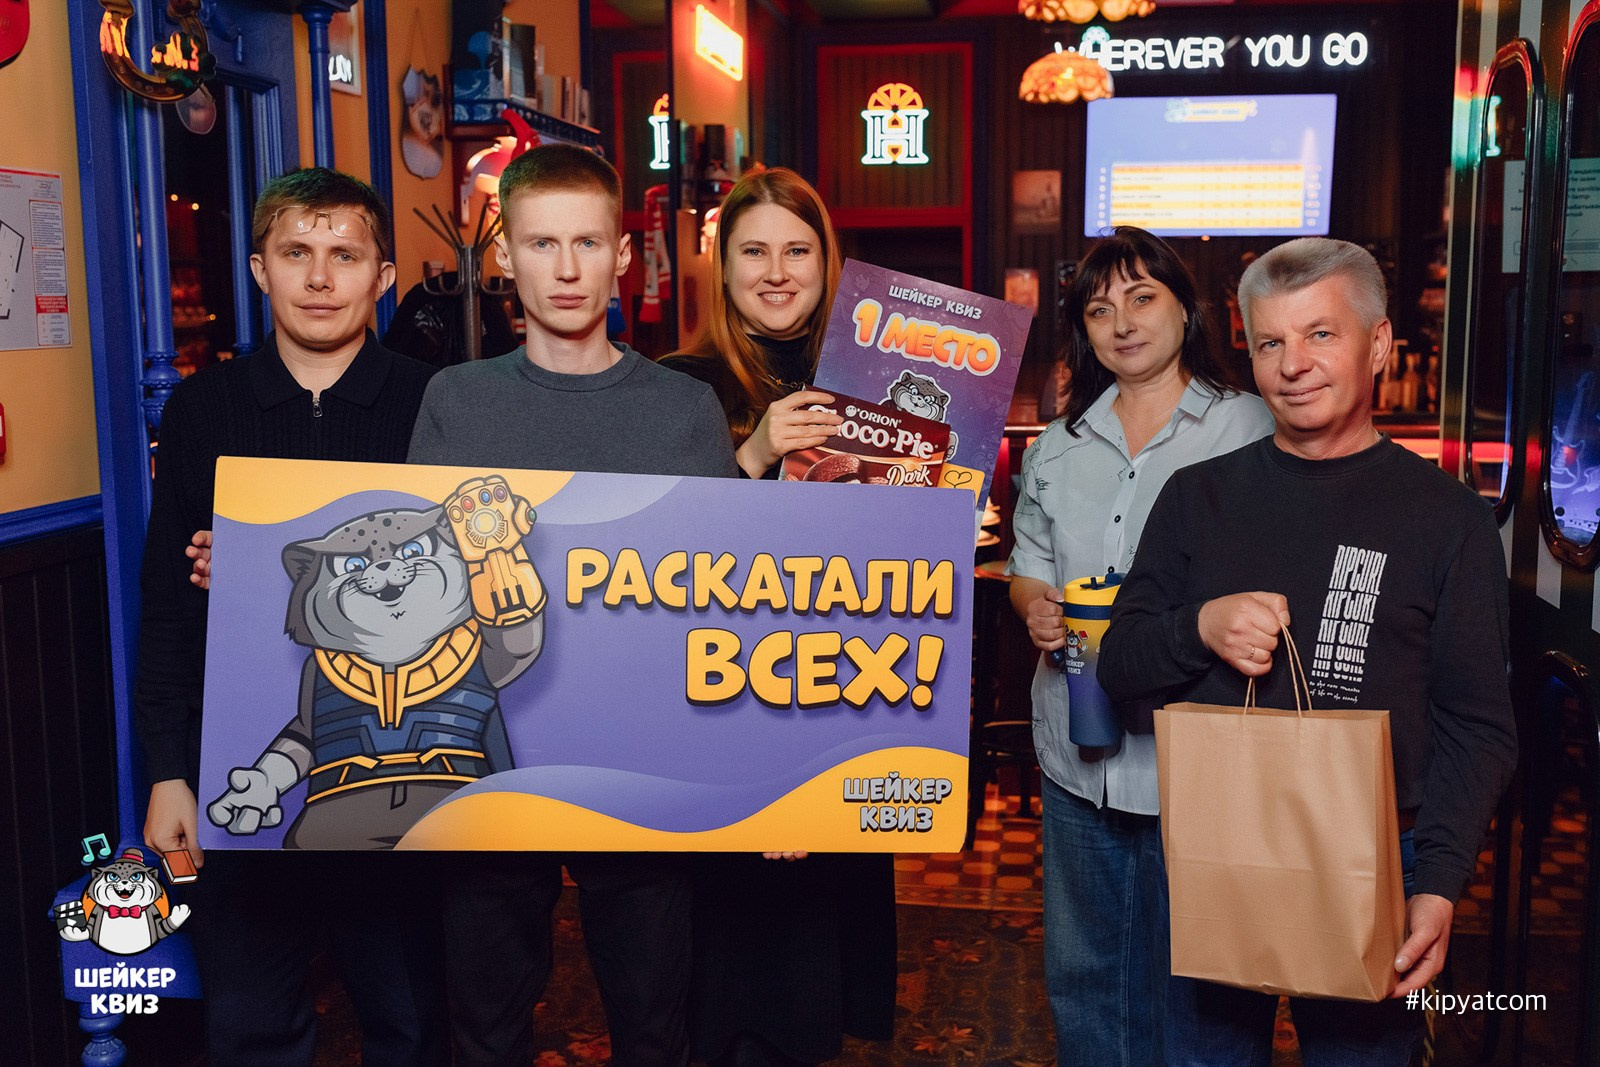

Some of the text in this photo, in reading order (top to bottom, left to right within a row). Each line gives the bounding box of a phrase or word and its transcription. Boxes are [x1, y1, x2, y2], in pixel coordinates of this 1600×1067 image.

[1244, 34, 1311, 68] YOU
[1322, 32, 1369, 67] GO
[888, 285, 983, 320] ШЕЙКЕР КВИЗ
[854, 299, 999, 374] 1 МЕСТО
[859, 409, 898, 428] ORION
[886, 464, 934, 486] Dark
[566, 547, 955, 619] РАСКАТАЛИ
[685, 627, 945, 712] ВСЕХ!
[843, 771, 953, 804] ШЕЙКЕР
[860, 806, 934, 833] КВИЗ
